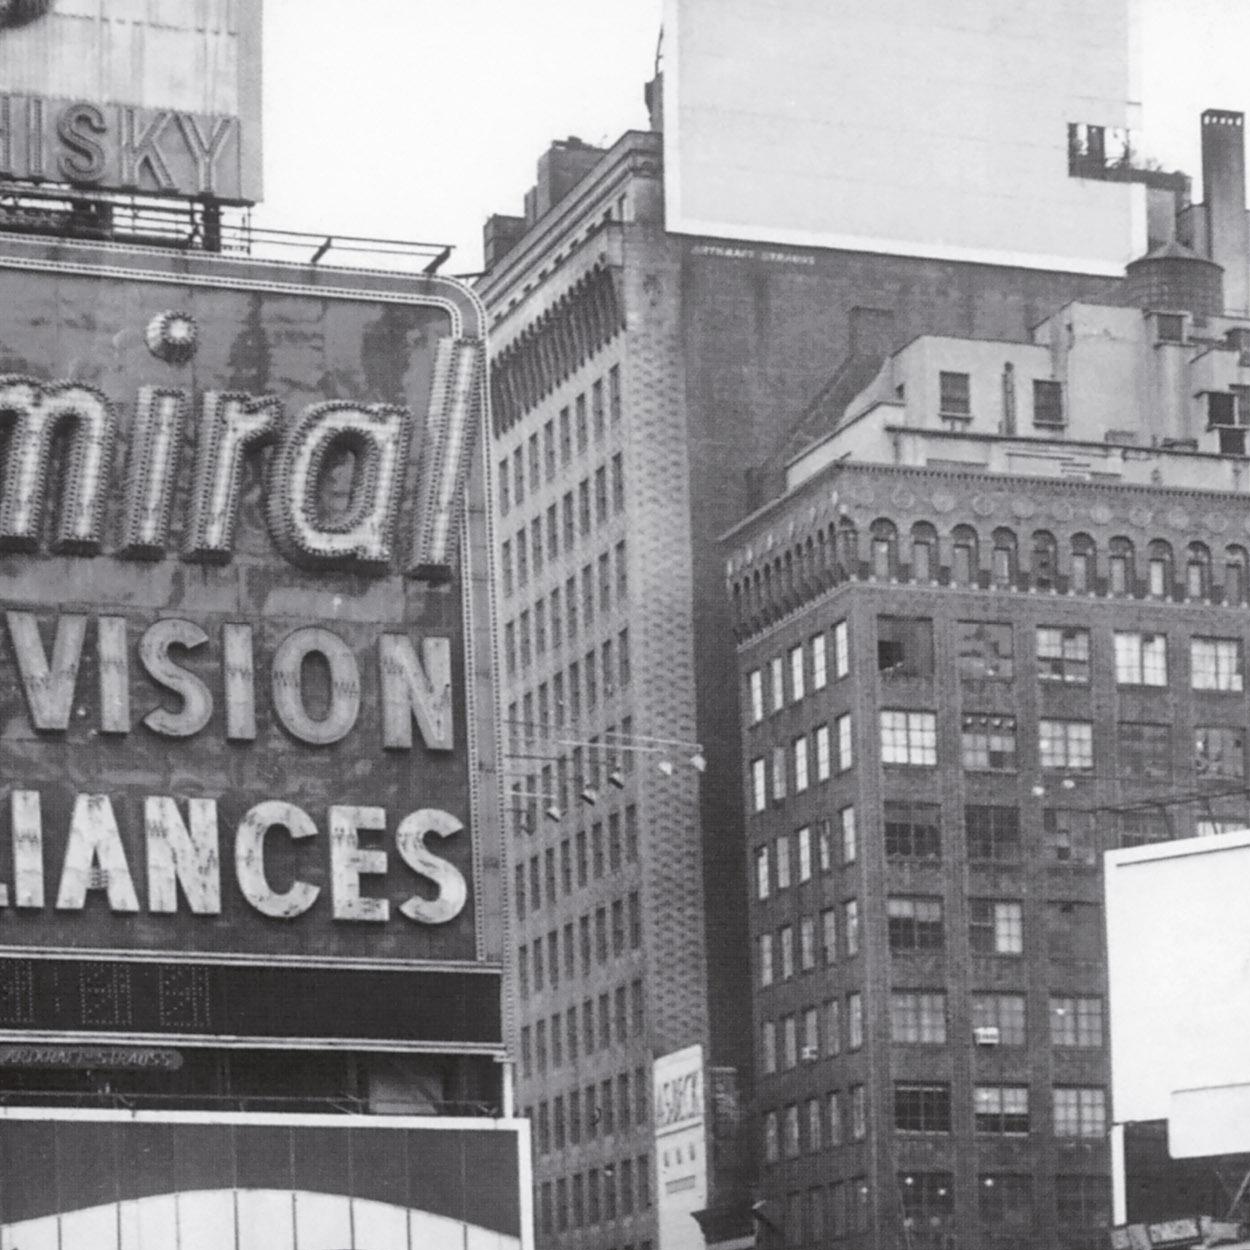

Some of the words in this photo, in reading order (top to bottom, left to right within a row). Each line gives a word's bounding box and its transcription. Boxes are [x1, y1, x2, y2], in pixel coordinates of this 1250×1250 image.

[0, 97, 239, 195] ISKY
[7, 611, 455, 750] VISION
[0, 789, 467, 924] IANCES
